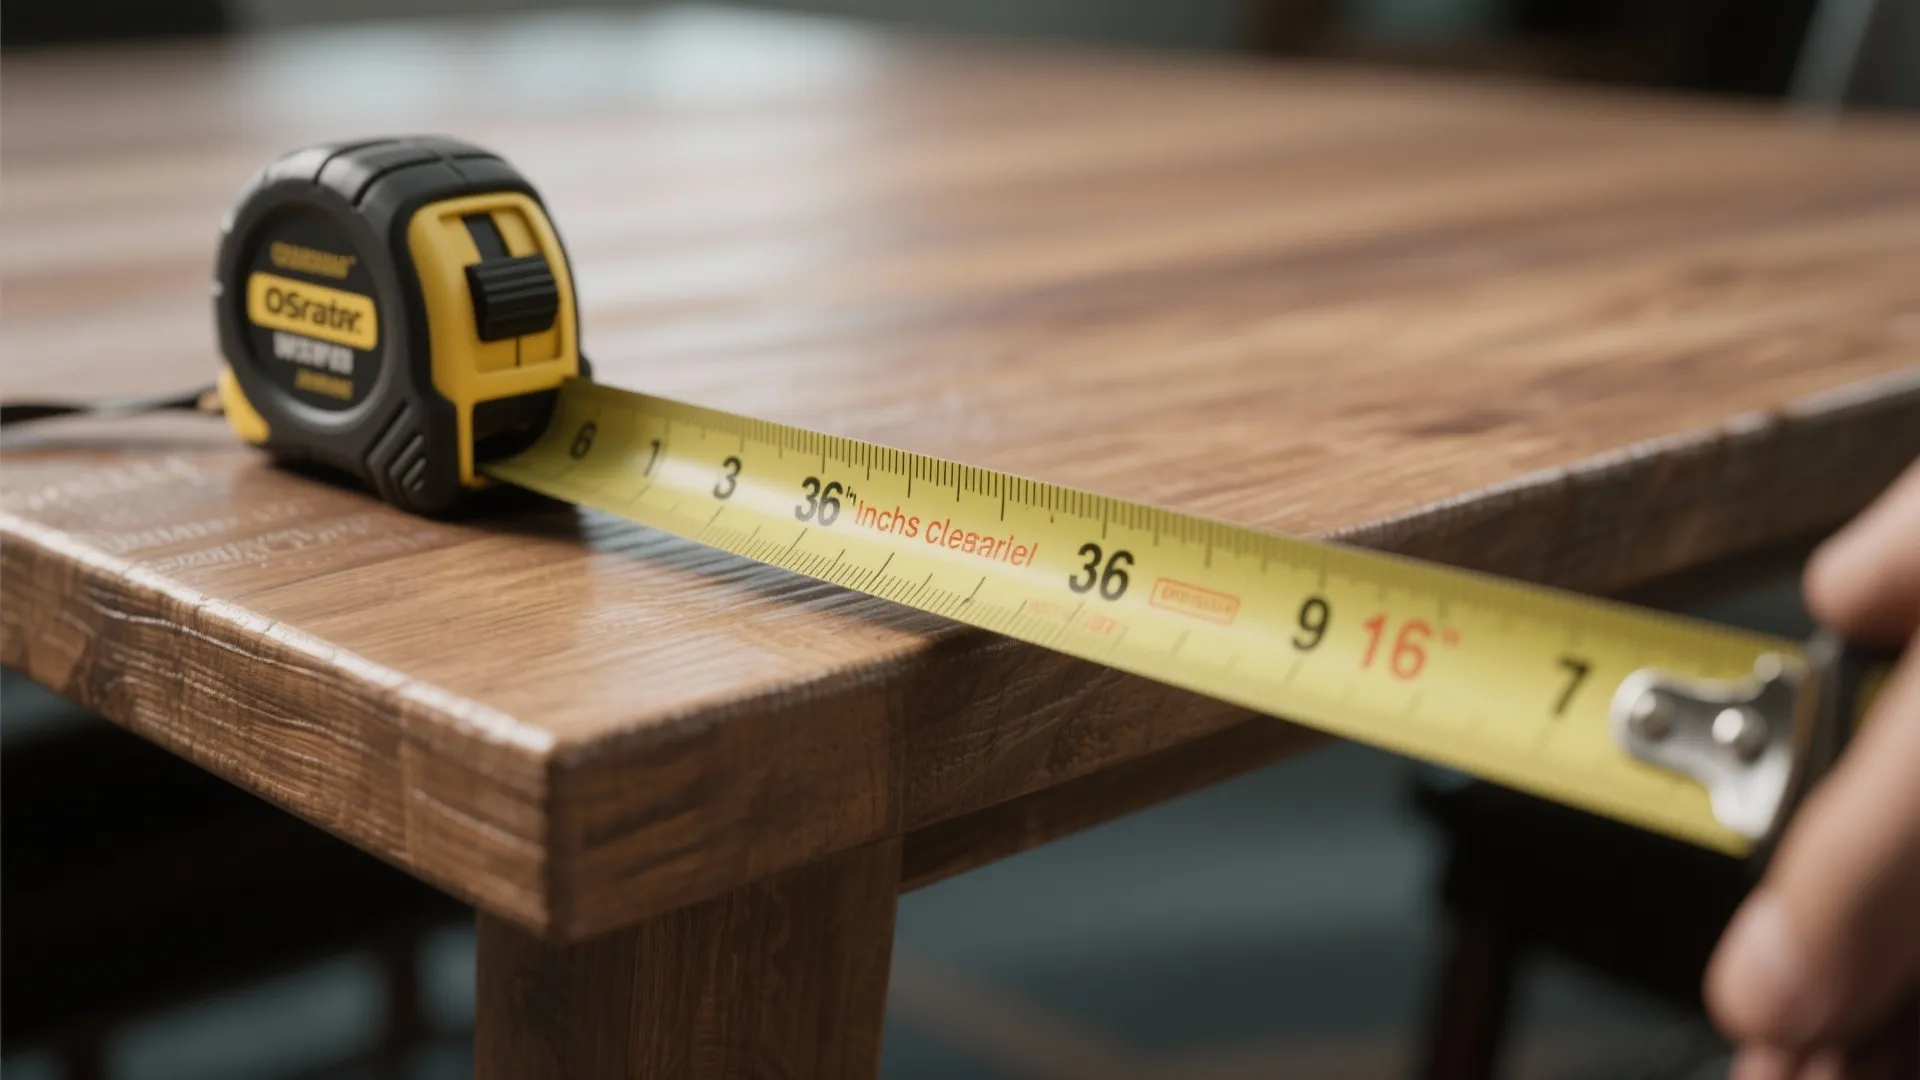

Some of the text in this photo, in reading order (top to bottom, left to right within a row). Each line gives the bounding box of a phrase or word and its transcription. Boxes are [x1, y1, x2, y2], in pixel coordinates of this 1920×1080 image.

[570, 421, 596, 460] 6
[644, 439, 662, 477] 1
[713, 456, 742, 500] 3
[1068, 542, 1135, 601] 36
[1292, 594, 1331, 651] 9
[1555, 653, 1594, 717] 7
